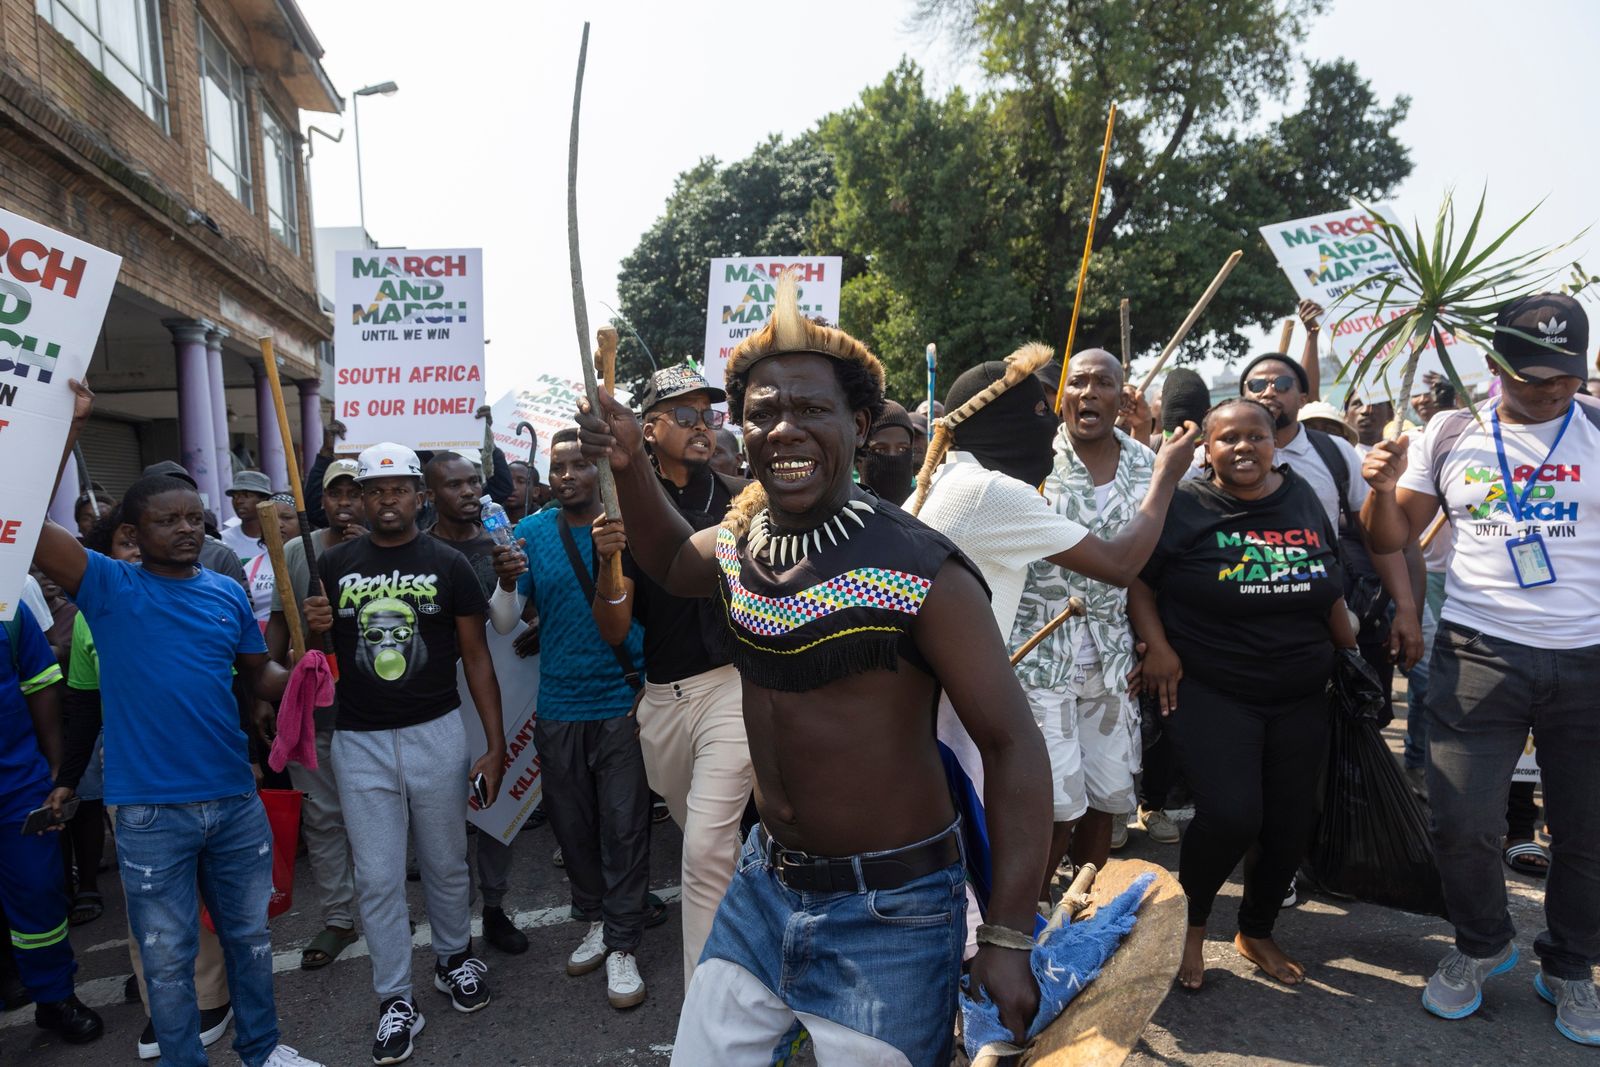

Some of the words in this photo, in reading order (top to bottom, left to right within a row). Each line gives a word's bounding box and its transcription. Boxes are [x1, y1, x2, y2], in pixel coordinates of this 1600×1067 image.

[1318, 236, 1378, 263] AND
[352, 255, 466, 279] MARCH
[374, 279, 444, 301] AND
[352, 302, 467, 325] MARCH
[362, 329, 398, 341] UNTIL
[403, 329, 422, 340] WE
[427, 328, 450, 340] WIN
[337, 366, 401, 385] SOUTH
[408, 364, 481, 383] AFRICA
[343, 401, 360, 417] IS
[367, 399, 405, 416] OUR
[413, 397, 476, 415] HOME!
[1216, 528, 1321, 548] MARCH
[1475, 525, 1512, 536] UNTIL
[1547, 525, 1576, 537] WIN
[1242, 546, 1309, 563] AND
[1218, 559, 1328, 582] MARCH
[338, 570, 438, 608] RECKLESS
[1240, 585, 1271, 594] UNTIL
[1273, 584, 1290, 593] WE
[1291, 582, 1311, 592] WIN
